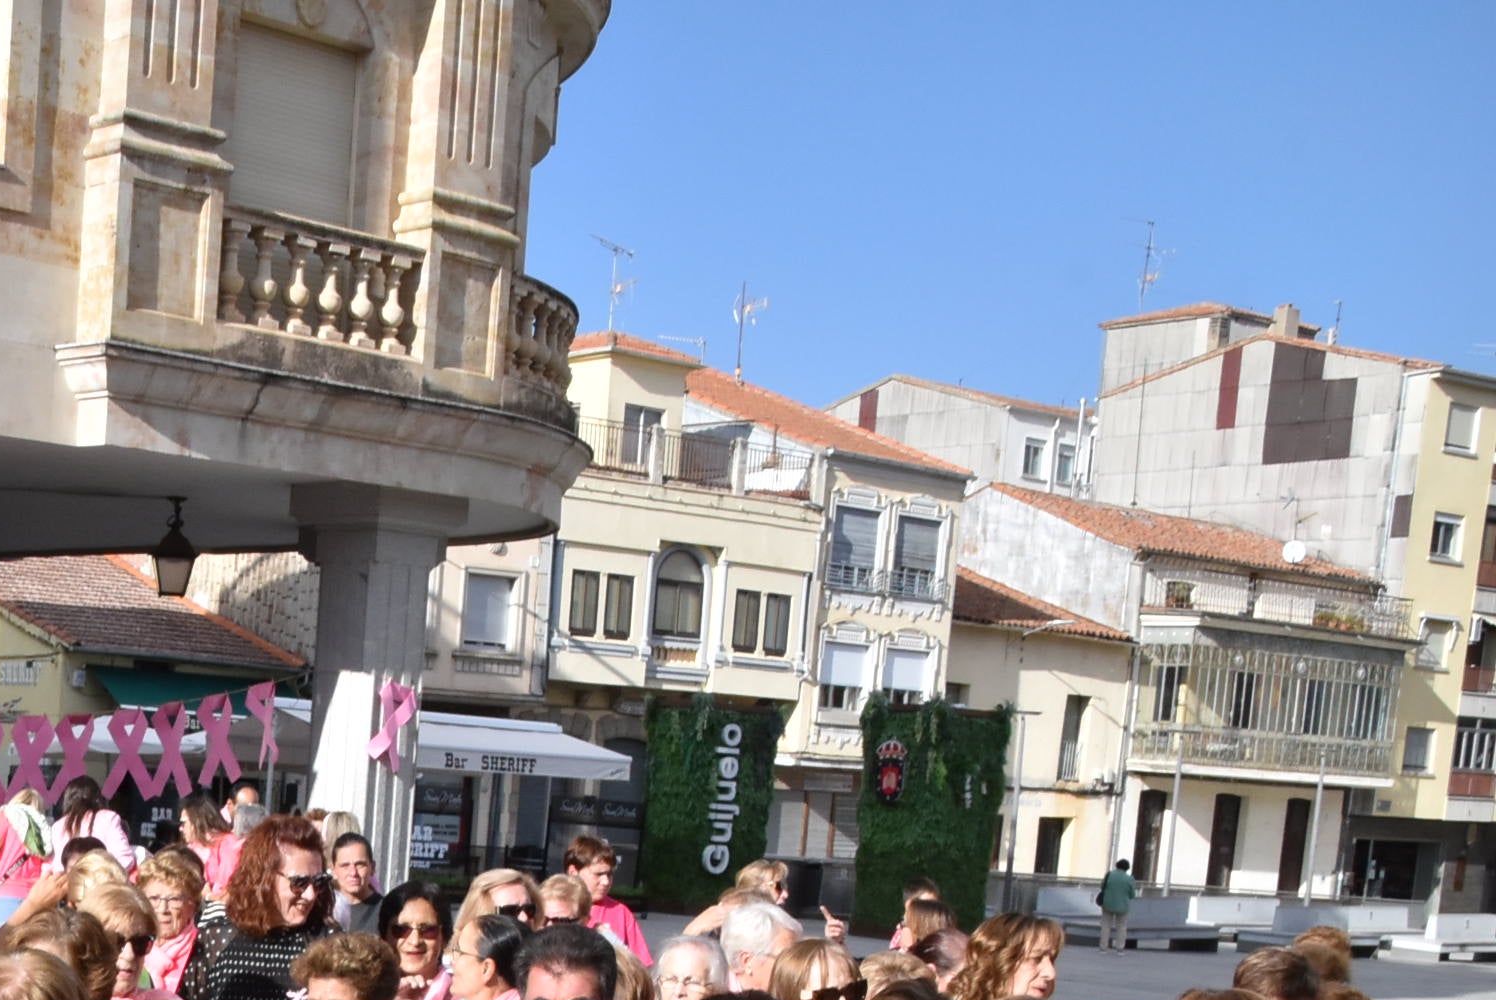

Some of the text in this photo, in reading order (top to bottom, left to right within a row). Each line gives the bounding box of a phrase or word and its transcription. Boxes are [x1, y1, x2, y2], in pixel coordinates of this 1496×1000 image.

[444, 752, 537, 774] Bar SHERIFF
[702, 723, 743, 875] Guijuelo
